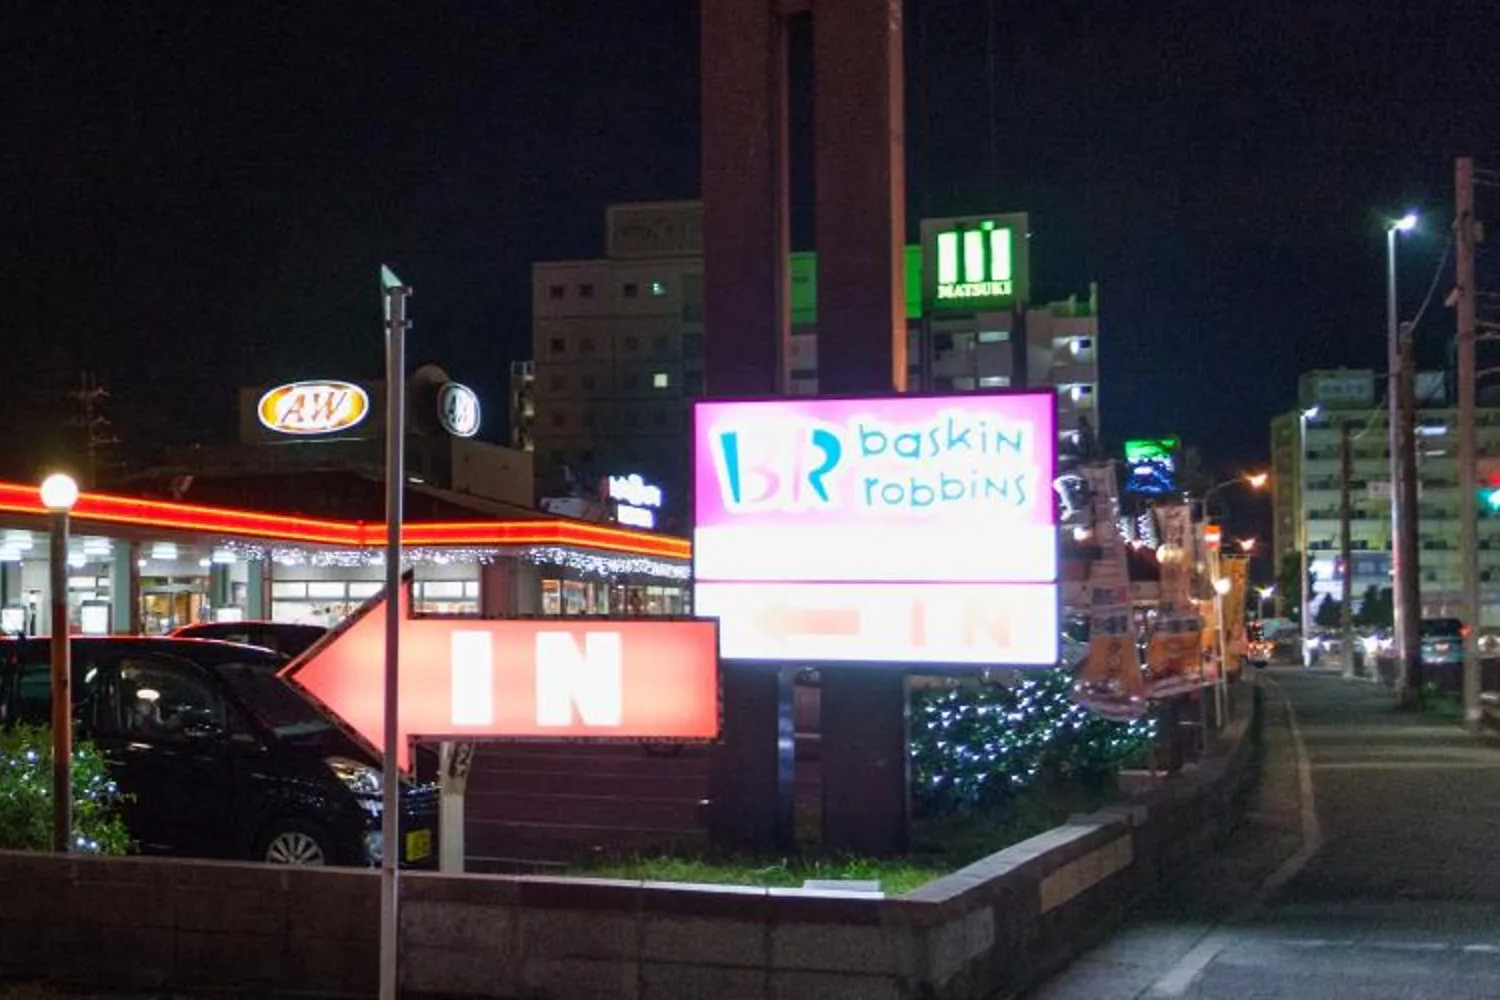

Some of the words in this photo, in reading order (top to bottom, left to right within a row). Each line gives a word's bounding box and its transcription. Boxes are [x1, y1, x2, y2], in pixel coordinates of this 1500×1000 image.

[281, 391, 348, 423] AW
[910, 599, 1012, 649] IN
[451, 630, 622, 727] IN
